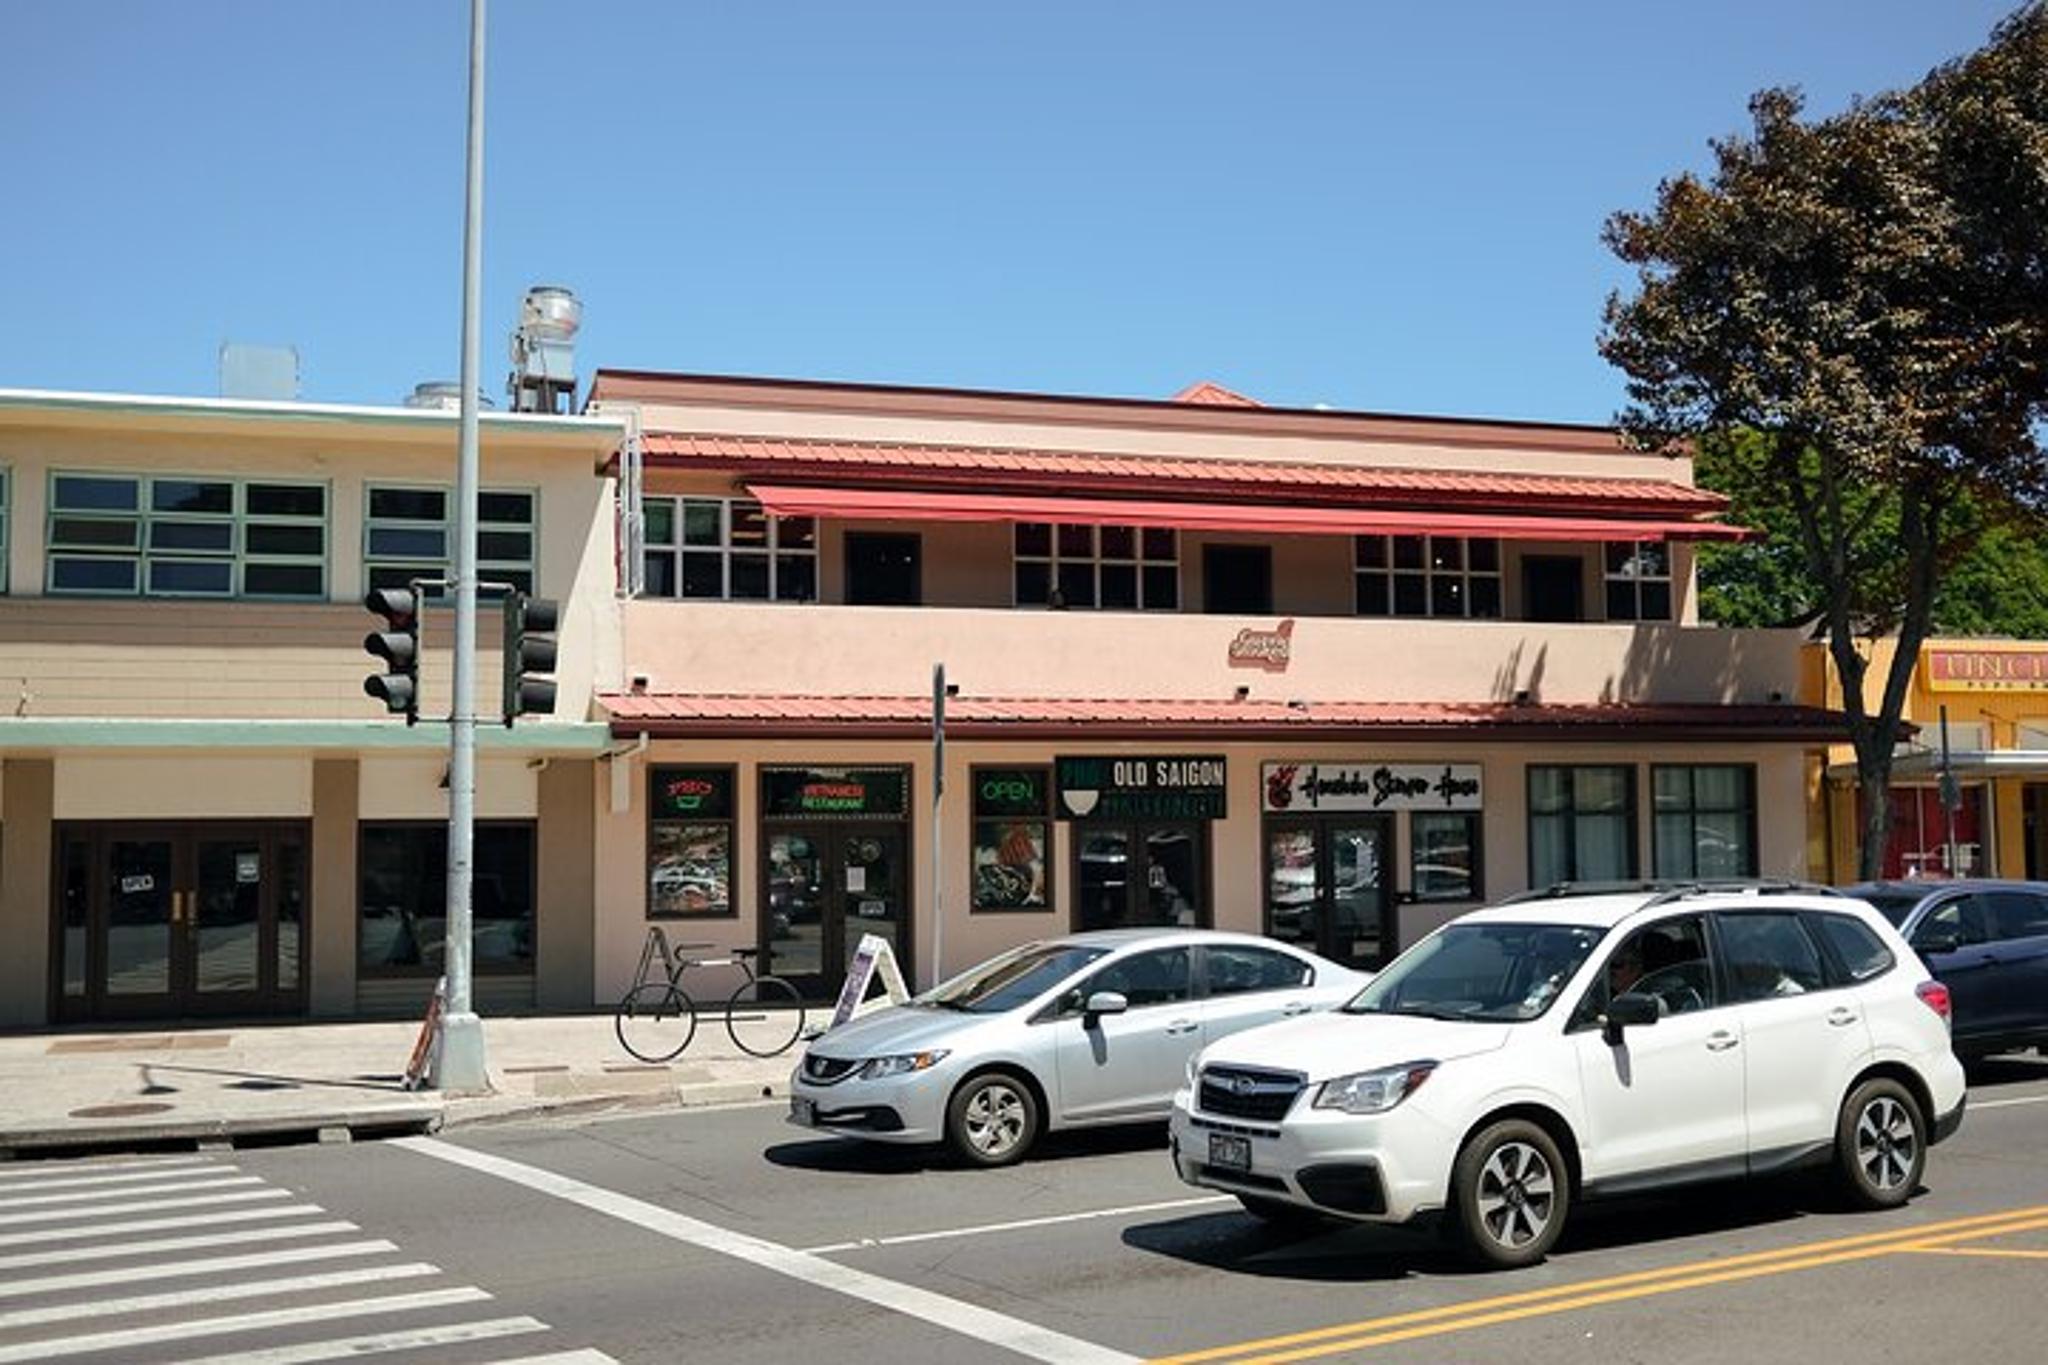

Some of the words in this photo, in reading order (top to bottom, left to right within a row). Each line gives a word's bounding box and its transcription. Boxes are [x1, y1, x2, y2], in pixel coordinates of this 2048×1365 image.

[1113, 761, 1148, 786] OLD
[1156, 761, 1224, 786] SAIGON
[981, 781, 1034, 801] OPEN
